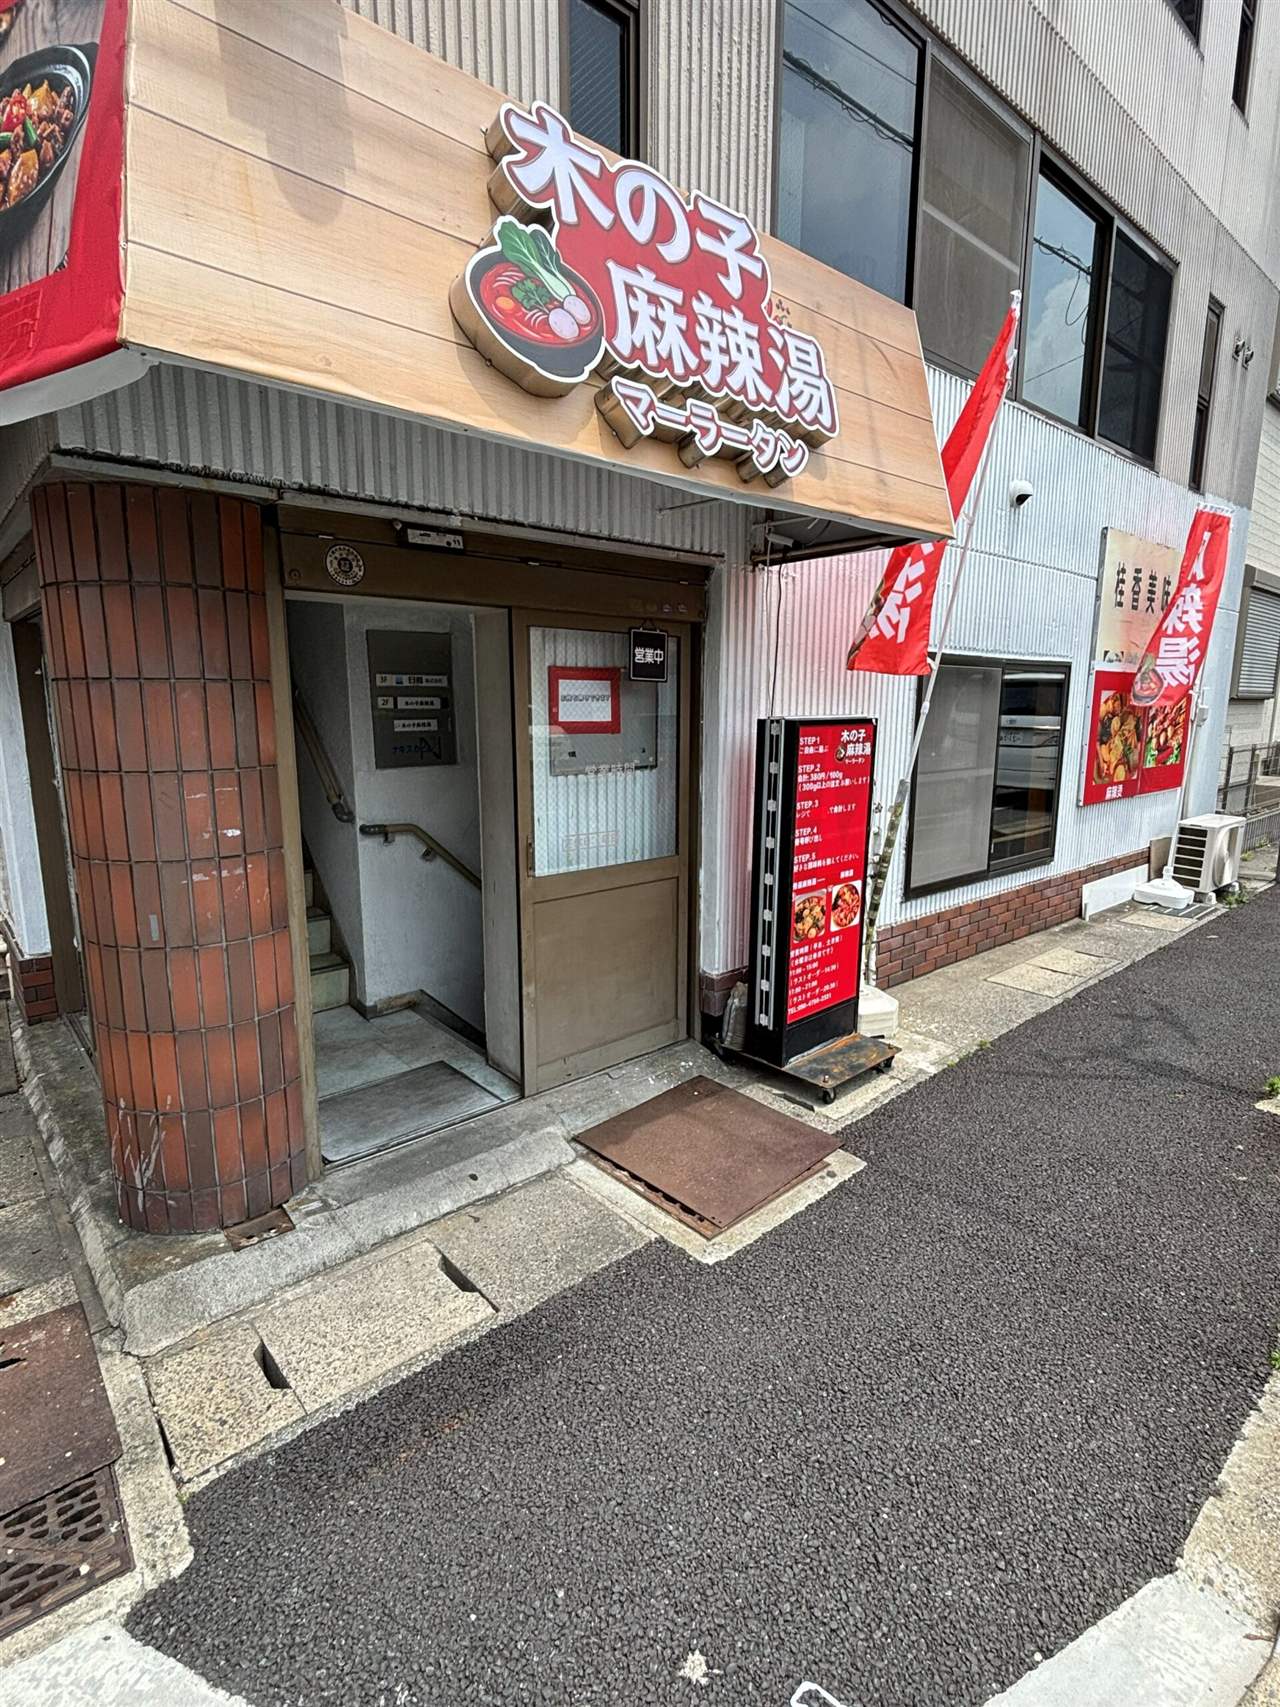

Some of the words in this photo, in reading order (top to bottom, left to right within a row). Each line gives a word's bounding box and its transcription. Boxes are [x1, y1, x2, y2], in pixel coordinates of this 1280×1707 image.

[507, 106, 764, 298] 木の子
[606, 260, 837, 431] 麻辣湯
[618, 384, 808, 473] マーラータン
[634, 646, 664, 664] 営業中
[841, 729, 866, 743] 木の子
[796, 800, 819, 810] STEP.3
[795, 827, 817, 837] STEP.4
[794, 853, 816, 863] STEP.5
